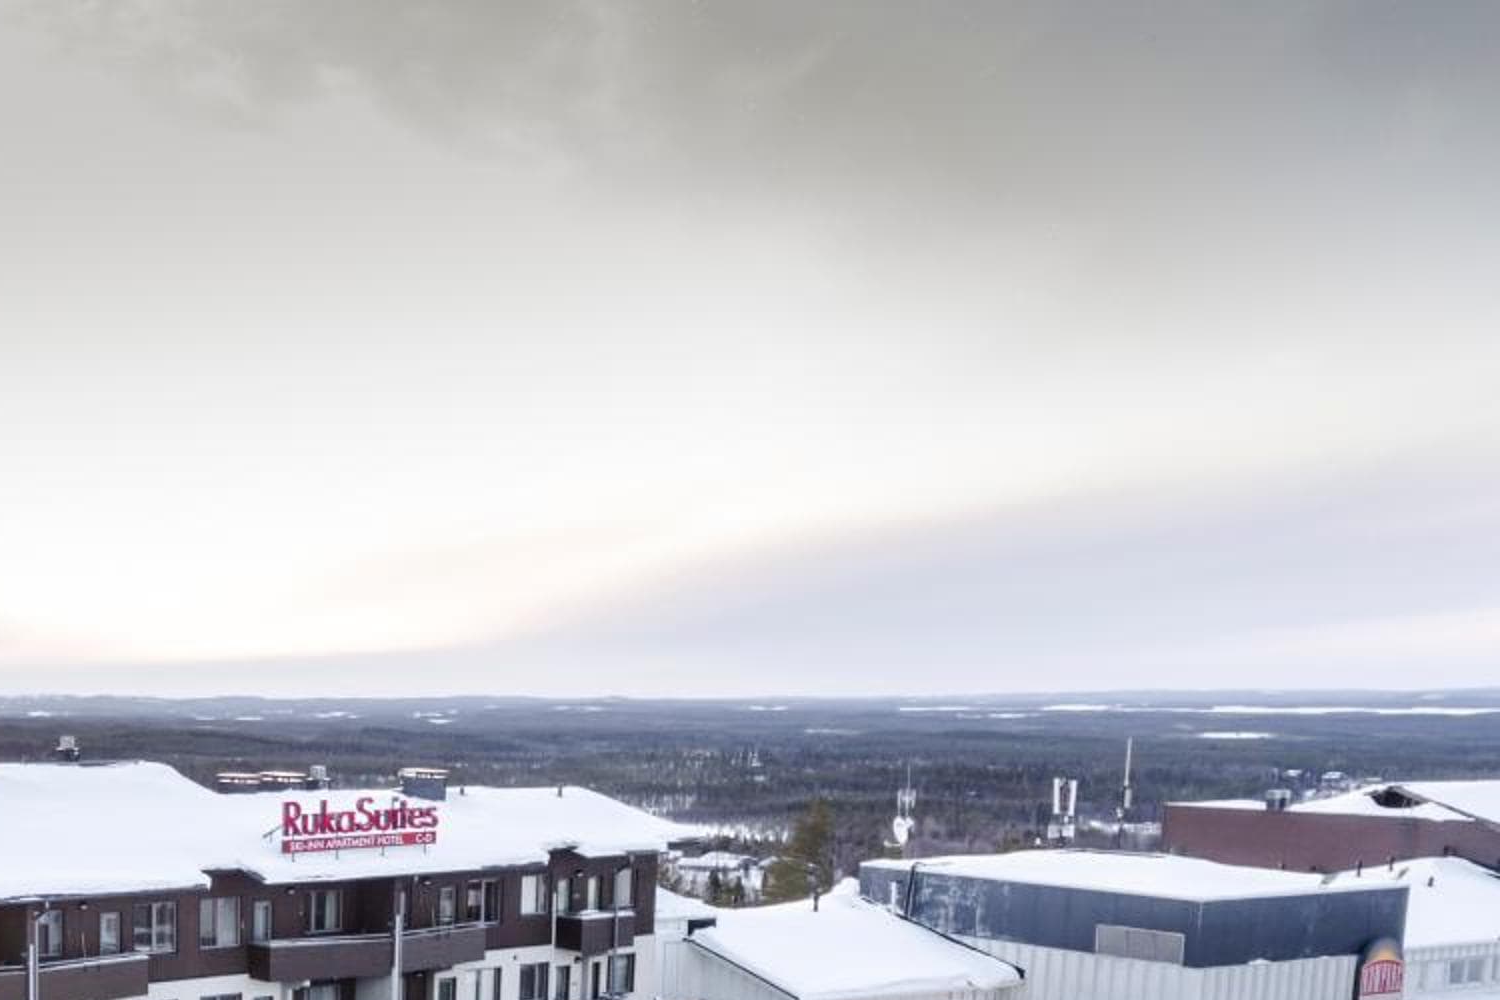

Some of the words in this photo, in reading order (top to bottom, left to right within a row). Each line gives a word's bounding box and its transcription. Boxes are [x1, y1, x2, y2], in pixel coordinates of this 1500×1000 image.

[282, 797, 438, 836] RukaSuites
[326, 835, 375, 848] APARTMENT
[377, 834, 403, 845] HOTEL
